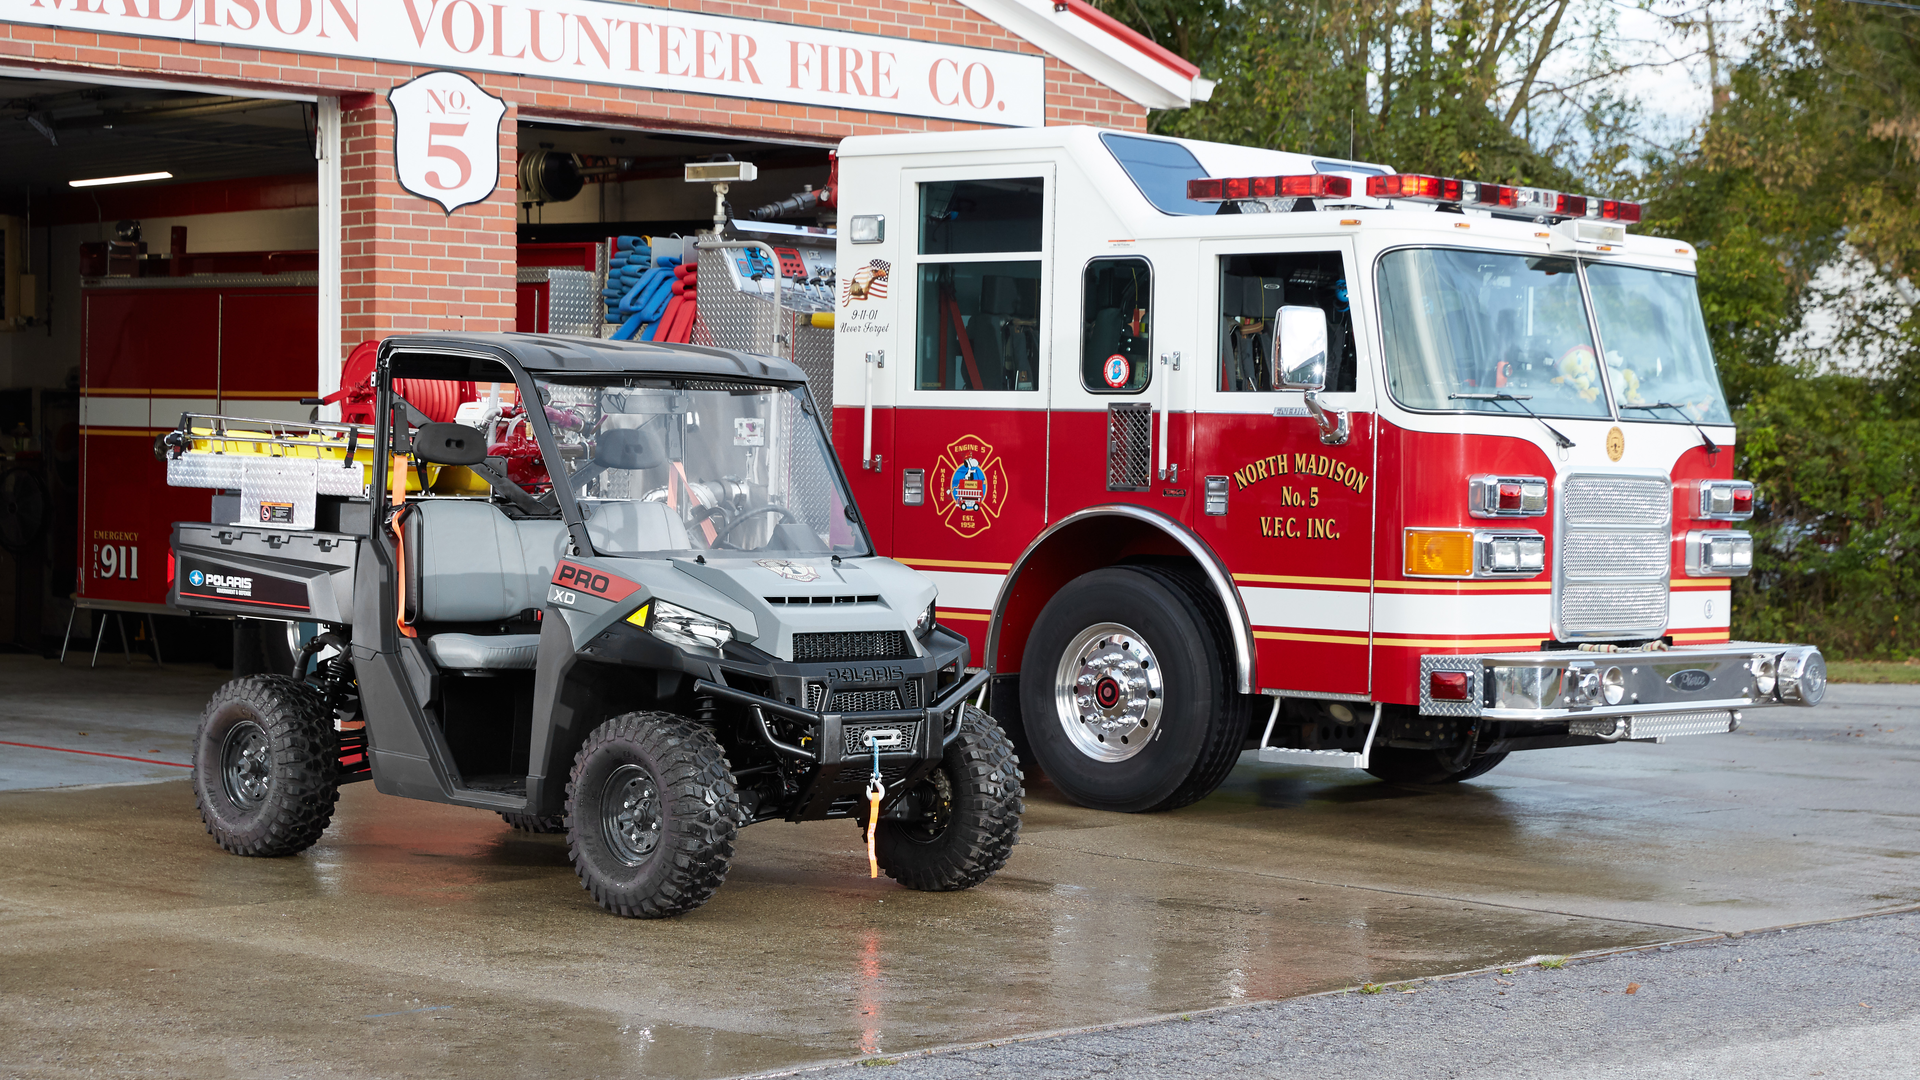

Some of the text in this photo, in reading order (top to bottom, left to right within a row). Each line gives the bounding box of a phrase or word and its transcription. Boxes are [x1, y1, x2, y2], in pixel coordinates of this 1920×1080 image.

[403, 0, 764, 85] VOLUNTEER
[785, 39, 900, 100] FIRE
[928, 57, 1006, 112] CO.
[424, 121, 472, 190] 5
[851, 309, 879, 321] 9-11-01
[839, 321, 890, 337] Never Forget
[954, 444, 979, 453] ENGINE
[1233, 452, 1369, 494] NORTH MADISON
[1281, 485, 1319, 508] No. 5
[93, 530, 139, 541] EMERGENCY
[1260, 516, 1341, 539] V.F.C. INC.
[100, 543, 139, 580] 911
[205, 573, 253, 589] POLARIS
[558, 564, 610, 594] PRO
[553, 589, 576, 605] XD
[826, 665, 904, 683] POLARIS
